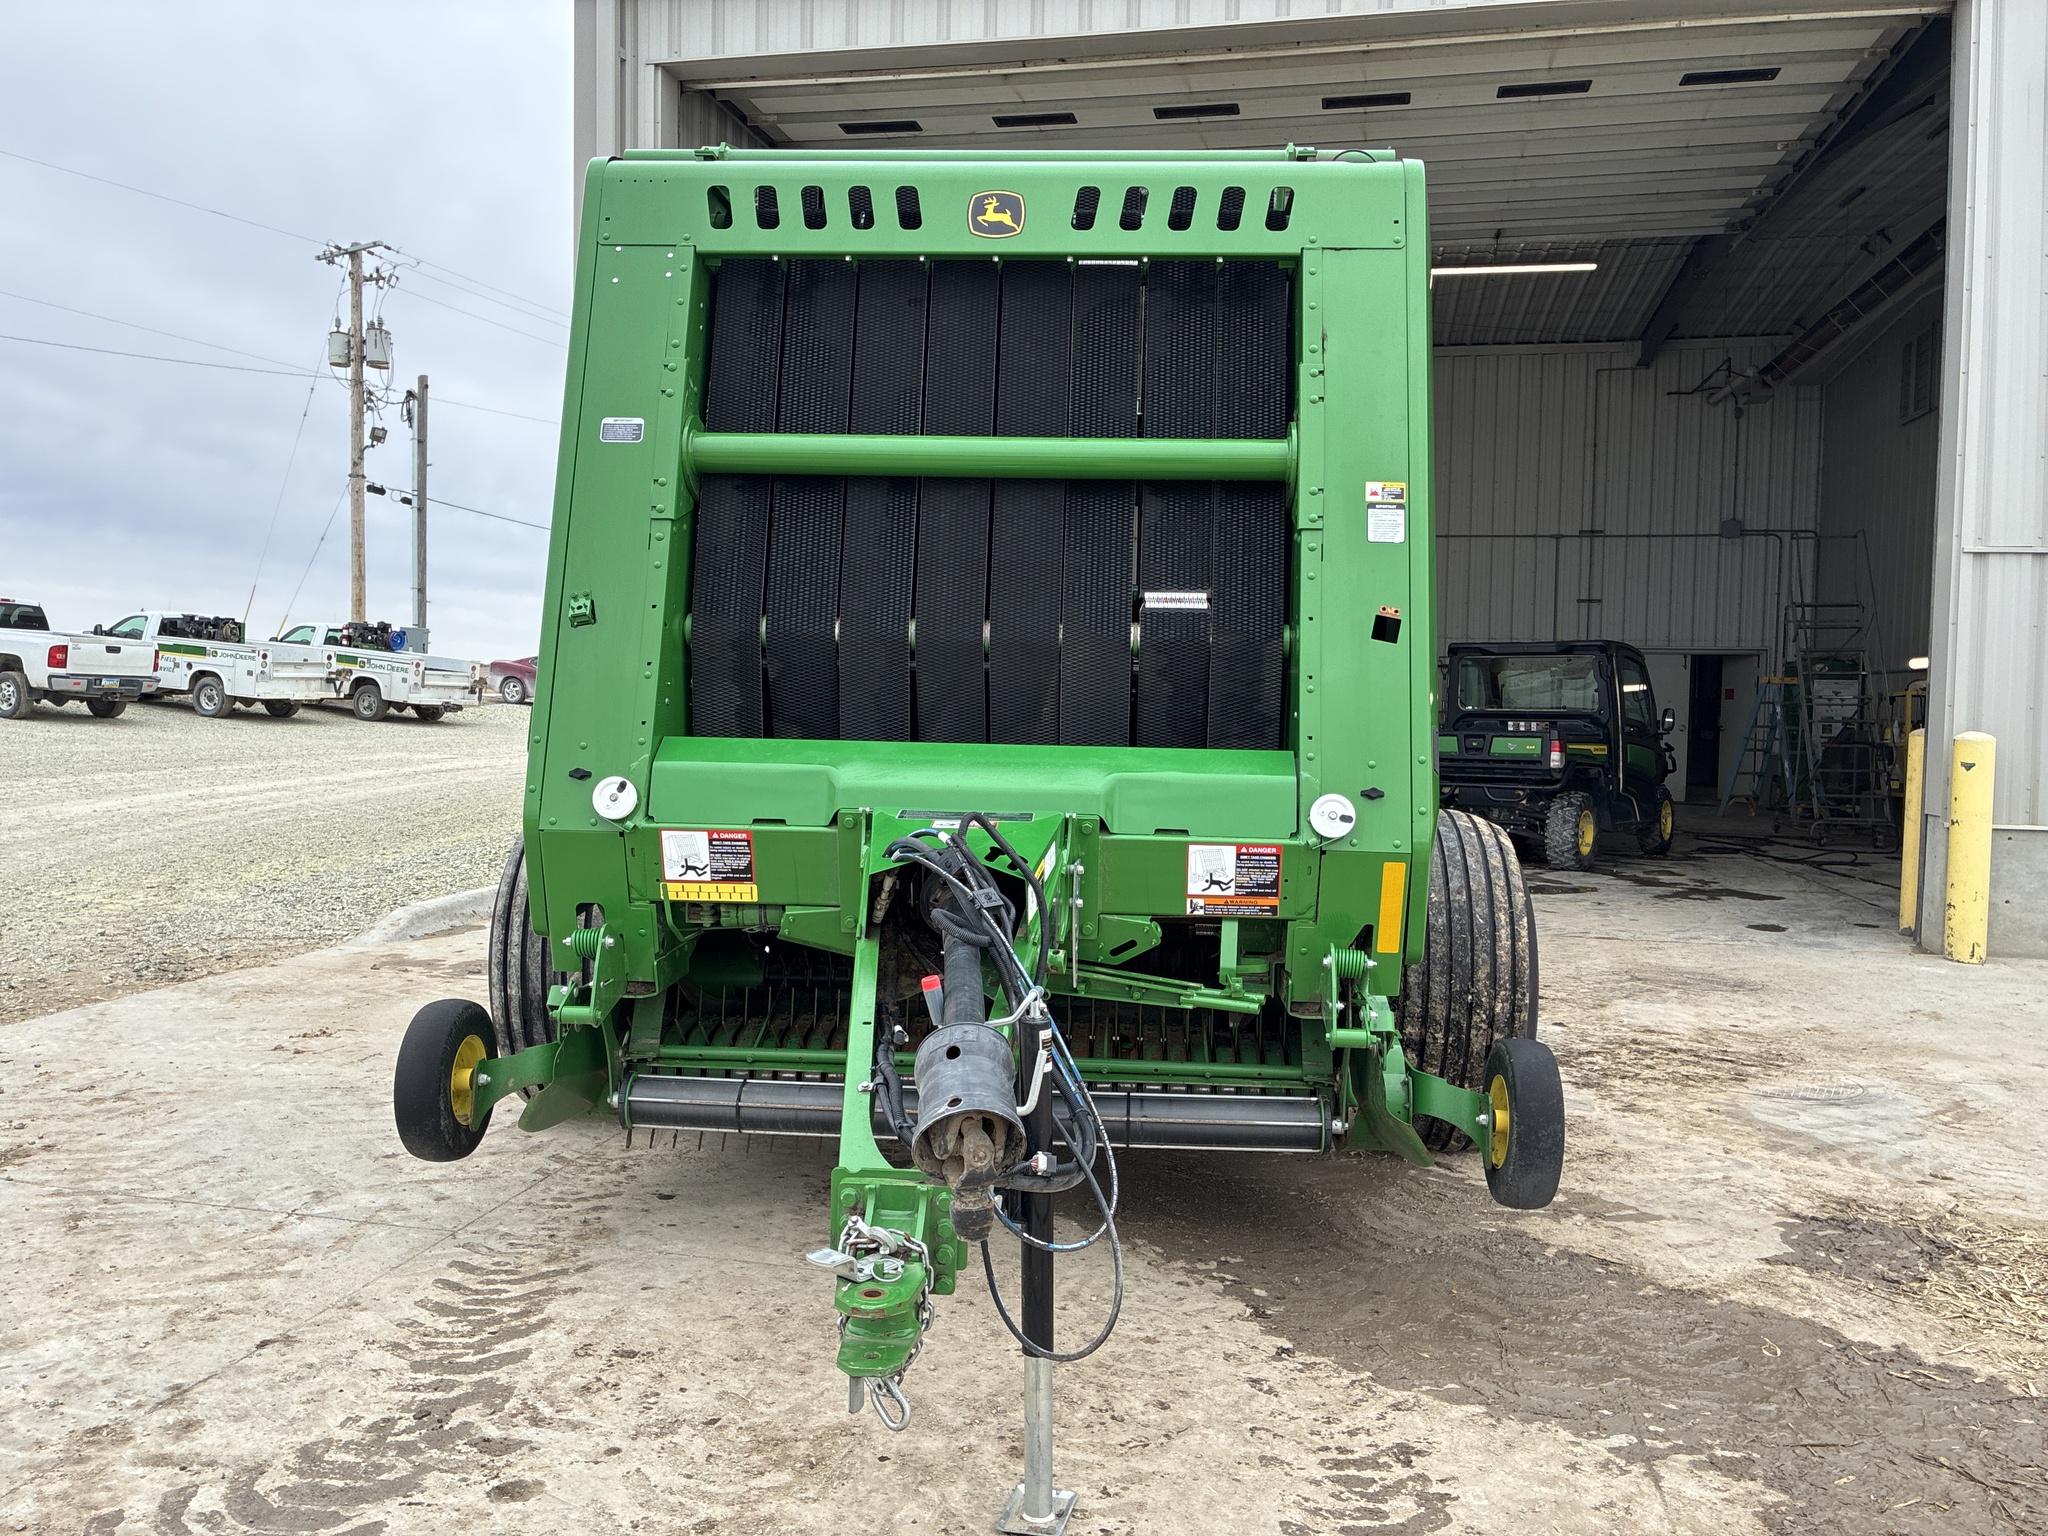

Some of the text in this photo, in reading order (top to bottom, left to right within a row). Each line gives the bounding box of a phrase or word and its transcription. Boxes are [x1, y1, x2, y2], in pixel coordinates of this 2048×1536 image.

[160, 654, 176, 662] FIELD
[219, 651, 256, 661] JOHN DEERE
[159, 665, 175, 673] RVICE
[367, 662, 409, 673] JOHN DEERE
